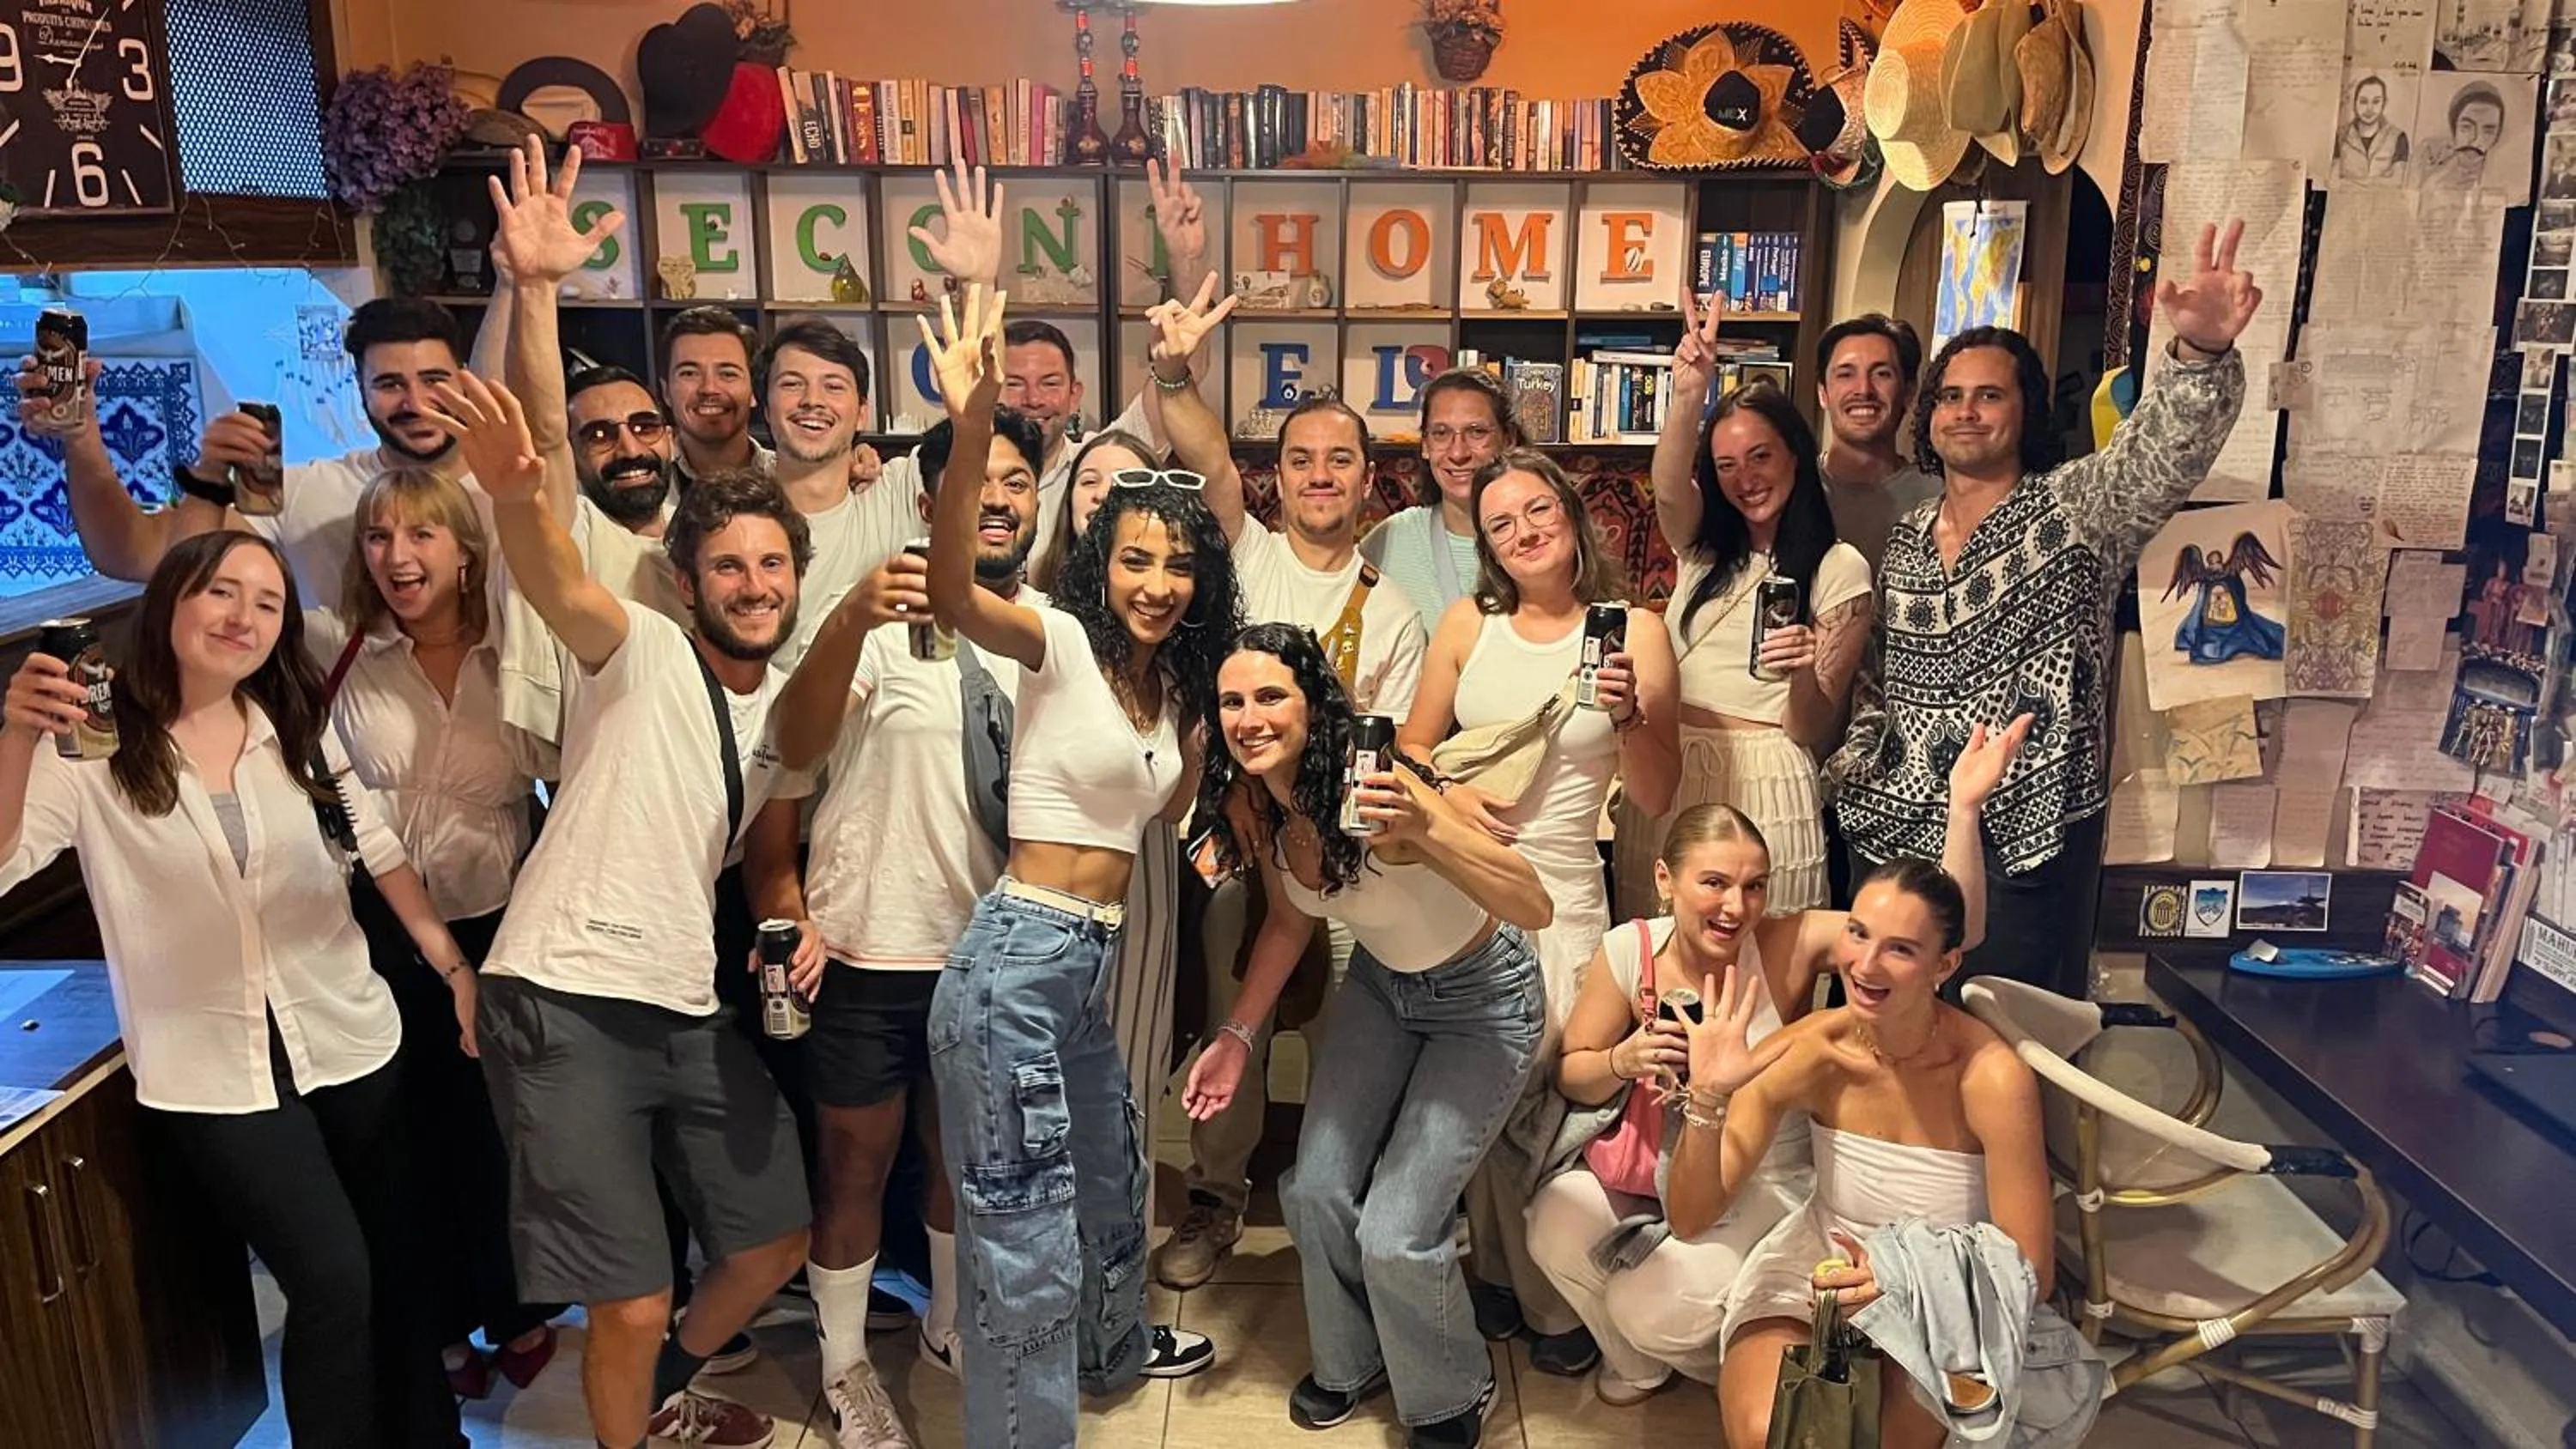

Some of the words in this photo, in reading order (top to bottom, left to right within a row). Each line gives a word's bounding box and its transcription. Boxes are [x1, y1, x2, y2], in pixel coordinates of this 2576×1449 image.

[118, 38, 154, 101] 3
[71, 142, 109, 207] 6
[1255, 209, 1655, 283] HOME
[1698, 249, 1711, 288] EUROPE
[1517, 378, 1558, 394] Turkey
